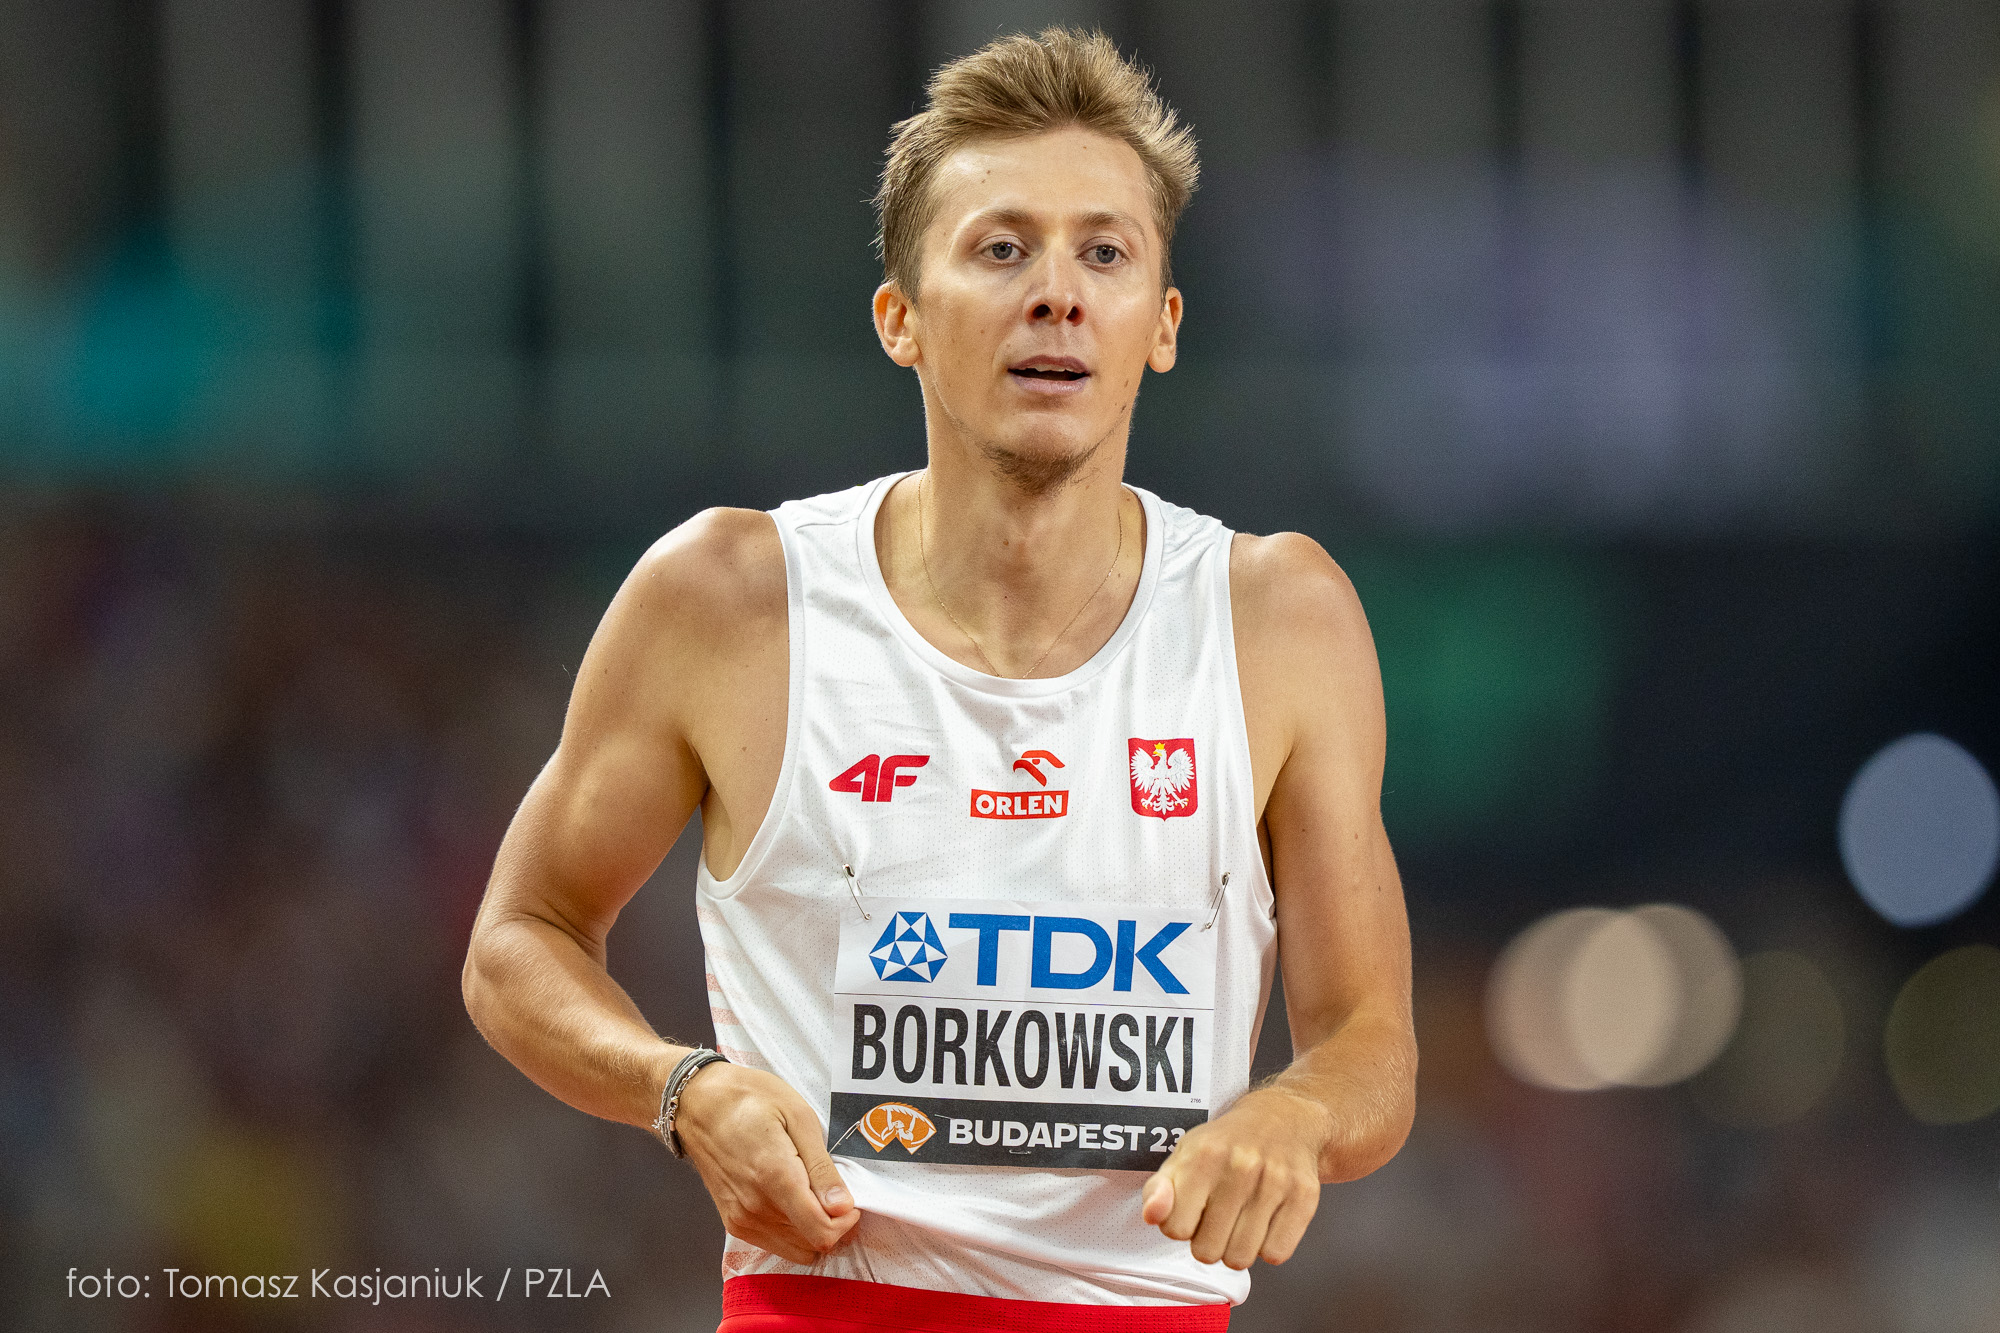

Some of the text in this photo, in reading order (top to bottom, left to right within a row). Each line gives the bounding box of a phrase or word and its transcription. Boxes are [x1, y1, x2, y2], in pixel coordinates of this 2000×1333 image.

[829, 753, 930, 802] 4F
[975, 793, 1063, 816] ORLEN
[948, 912, 1193, 994] TDK
[851, 1003, 1195, 1094] BORKOWSKI
[948, 1118, 1146, 1152] BUDAPEST
